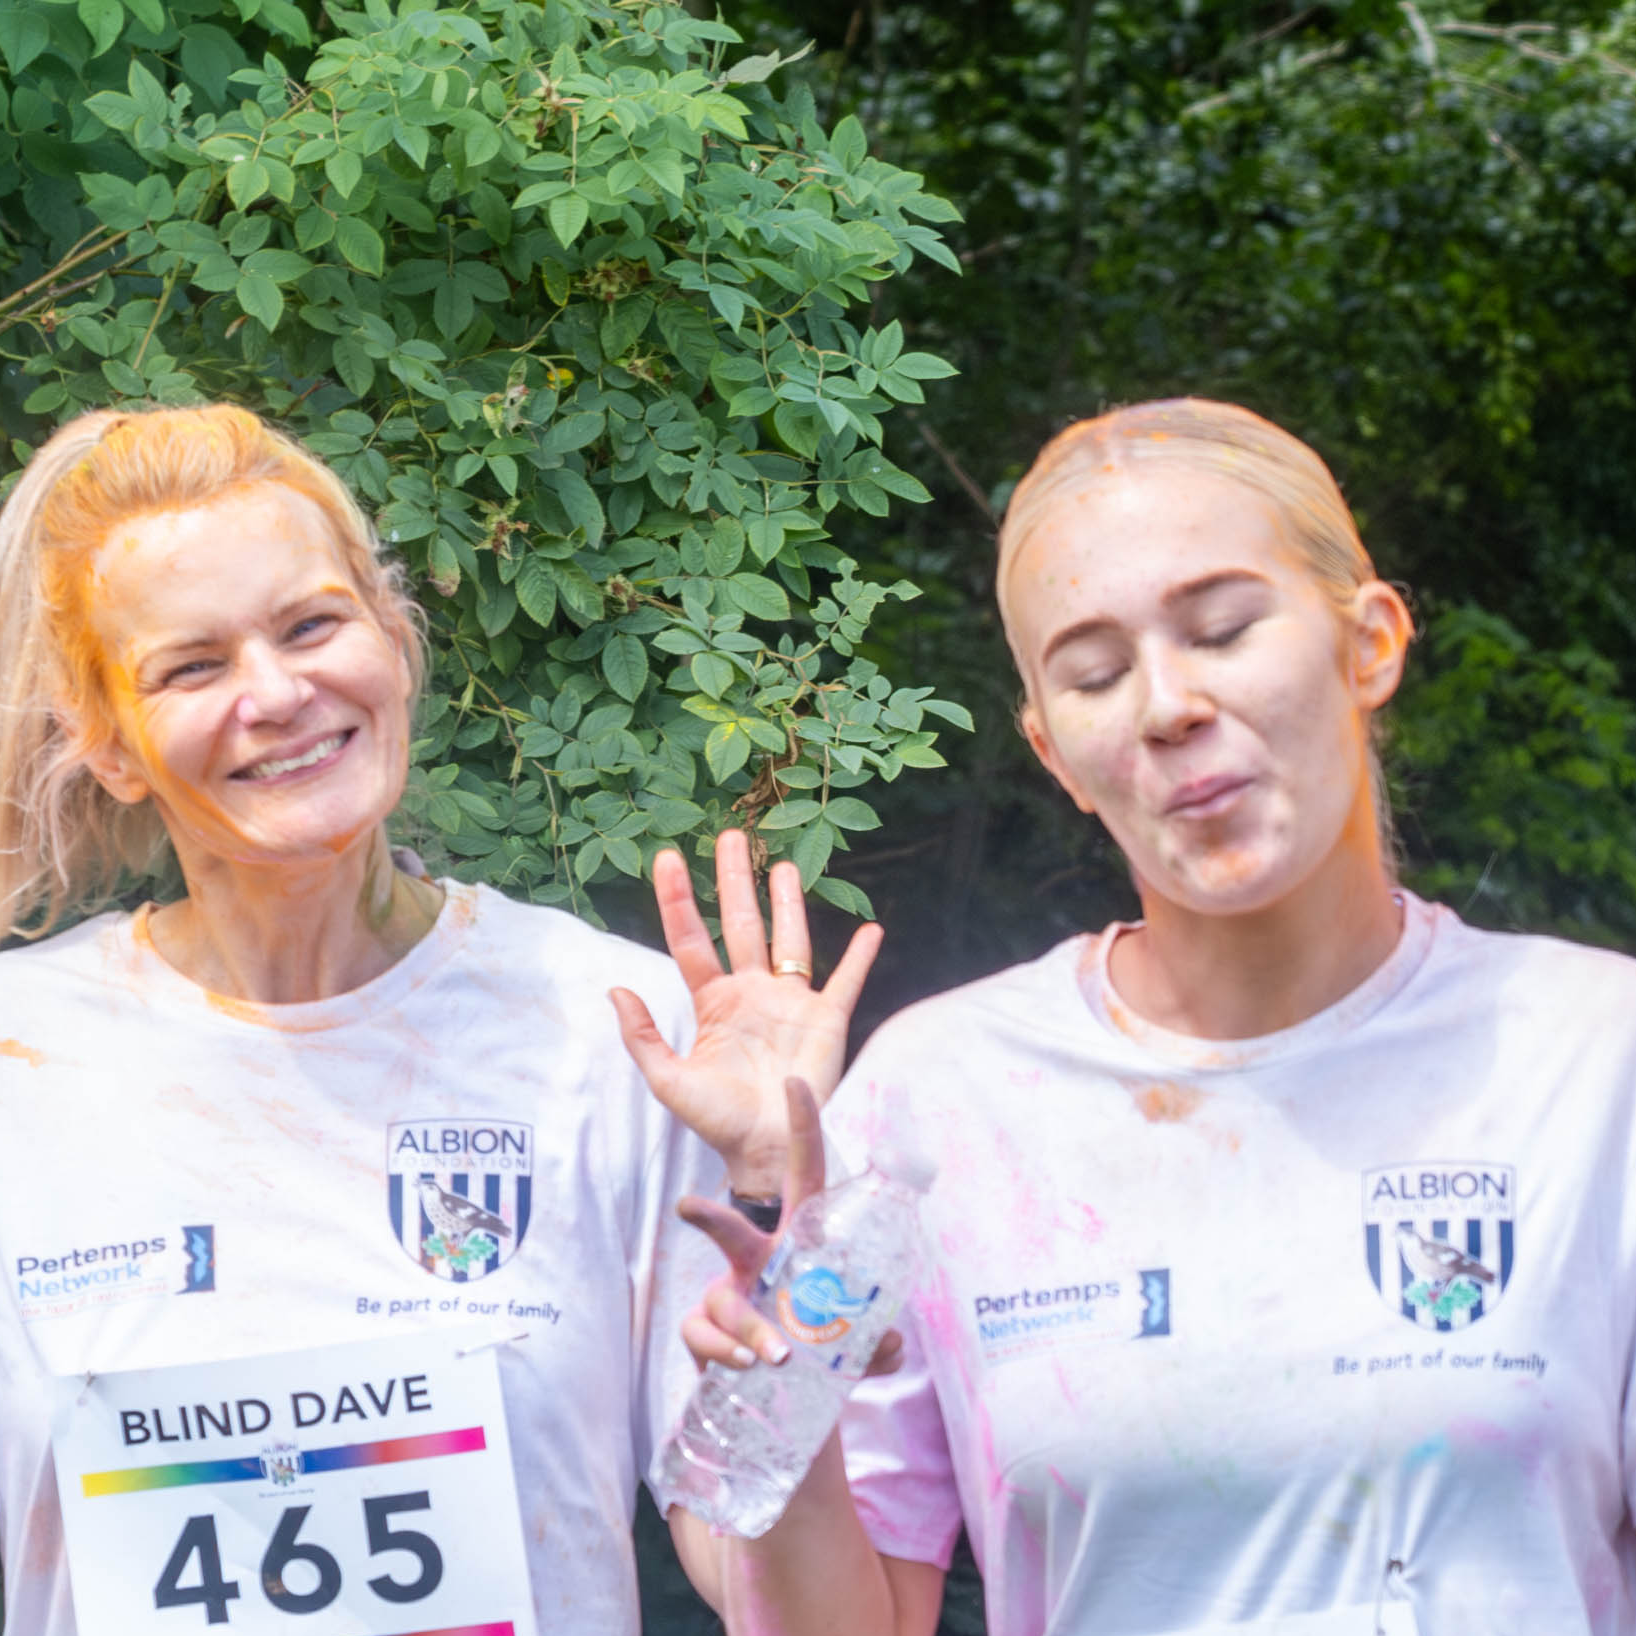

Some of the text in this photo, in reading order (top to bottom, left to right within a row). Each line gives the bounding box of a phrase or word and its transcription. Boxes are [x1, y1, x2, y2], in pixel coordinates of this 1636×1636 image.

[395, 1127, 526, 1154] ALBION
[1371, 1171, 1508, 1200] ALBION
[17, 1237, 167, 1276] Pertemps
[18, 1262, 142, 1299] Network
[356, 1296, 562, 1325] Be part of our family
[974, 1281, 1120, 1317] Pertemps
[978, 1306, 1095, 1339] Network
[1332, 1347, 1547, 1379] Be part of our family
[119, 1374, 432, 1446] BLIND DAVE
[153, 1489, 444, 1626] 465
